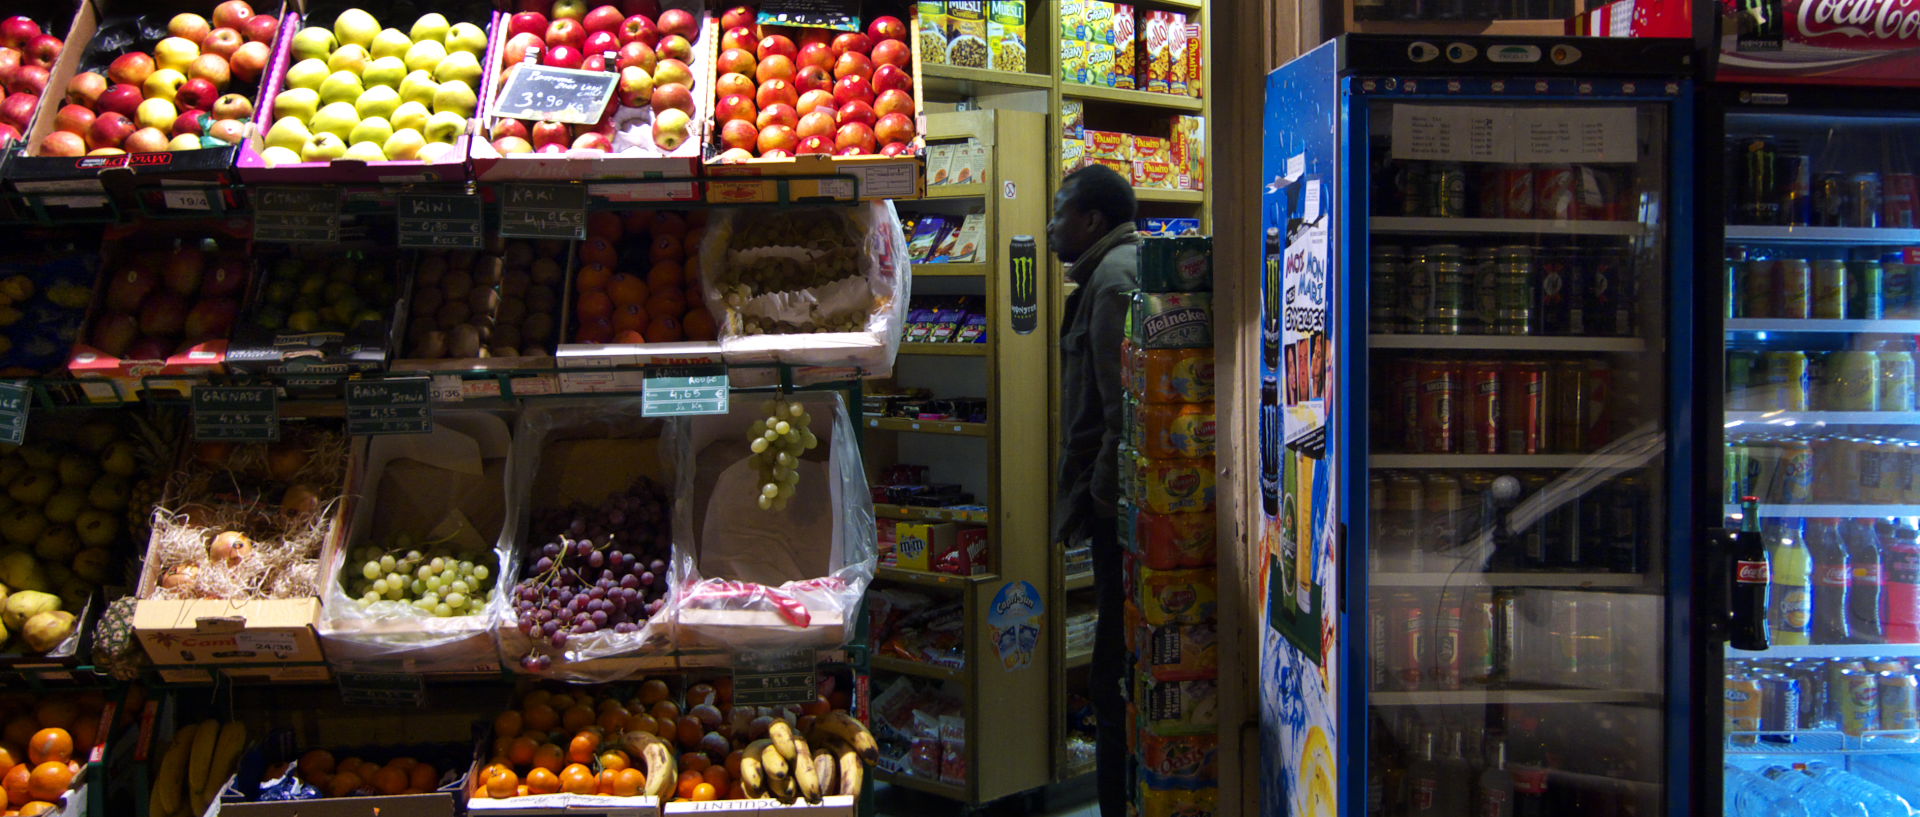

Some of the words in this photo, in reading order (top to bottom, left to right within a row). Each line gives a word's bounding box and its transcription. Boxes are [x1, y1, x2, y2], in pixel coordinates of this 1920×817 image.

[992, 1, 1022, 18] MUESLI
[1094, 131, 1121, 145] PALMITO
[1135, 136, 1161, 149] PALMITO
[1144, 162, 1170, 174] PALMITO
[202, 390, 262, 402] GRENADE
[714, 390, 725, 399] €
[996, 592, 1036, 615] Capri-Sun
[255, 642, 293, 651] 24/36
[1161, 747, 1205, 775] Oasis
